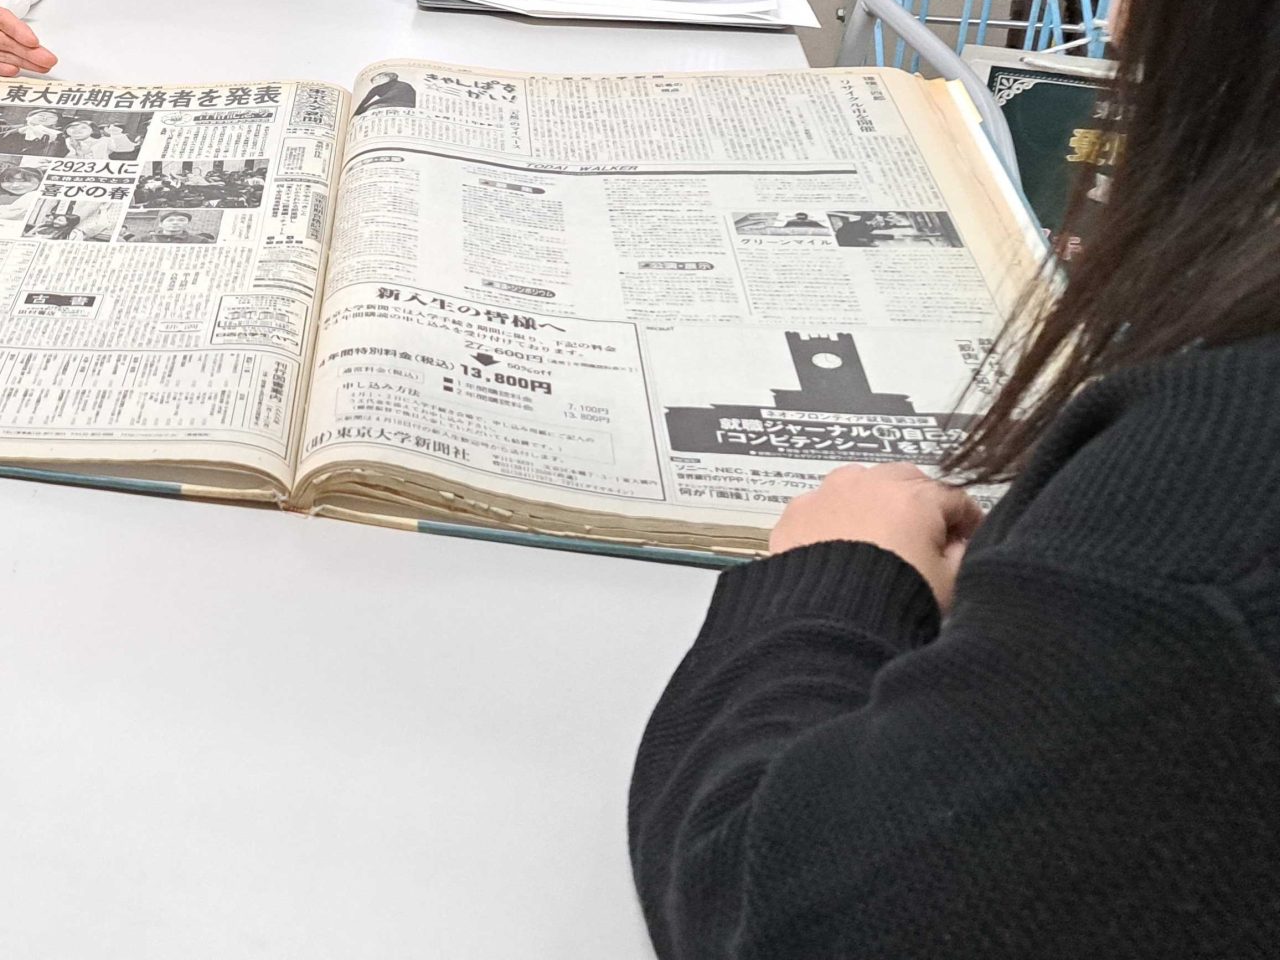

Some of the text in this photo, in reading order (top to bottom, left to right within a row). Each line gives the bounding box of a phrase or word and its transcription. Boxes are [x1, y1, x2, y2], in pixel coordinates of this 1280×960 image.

[0, 84, 282, 110] 東大前期合格者を発表
[50, 160, 140, 175] 2923人に
[525, 163, 569, 171] TODAI
[40, 183, 130, 200] 喜びの春
[740, 238, 833, 246] グリーンマイル
[377, 286, 568, 333] 新入生の皆様へ
[342, 382, 422, 398] 申し込み方法
